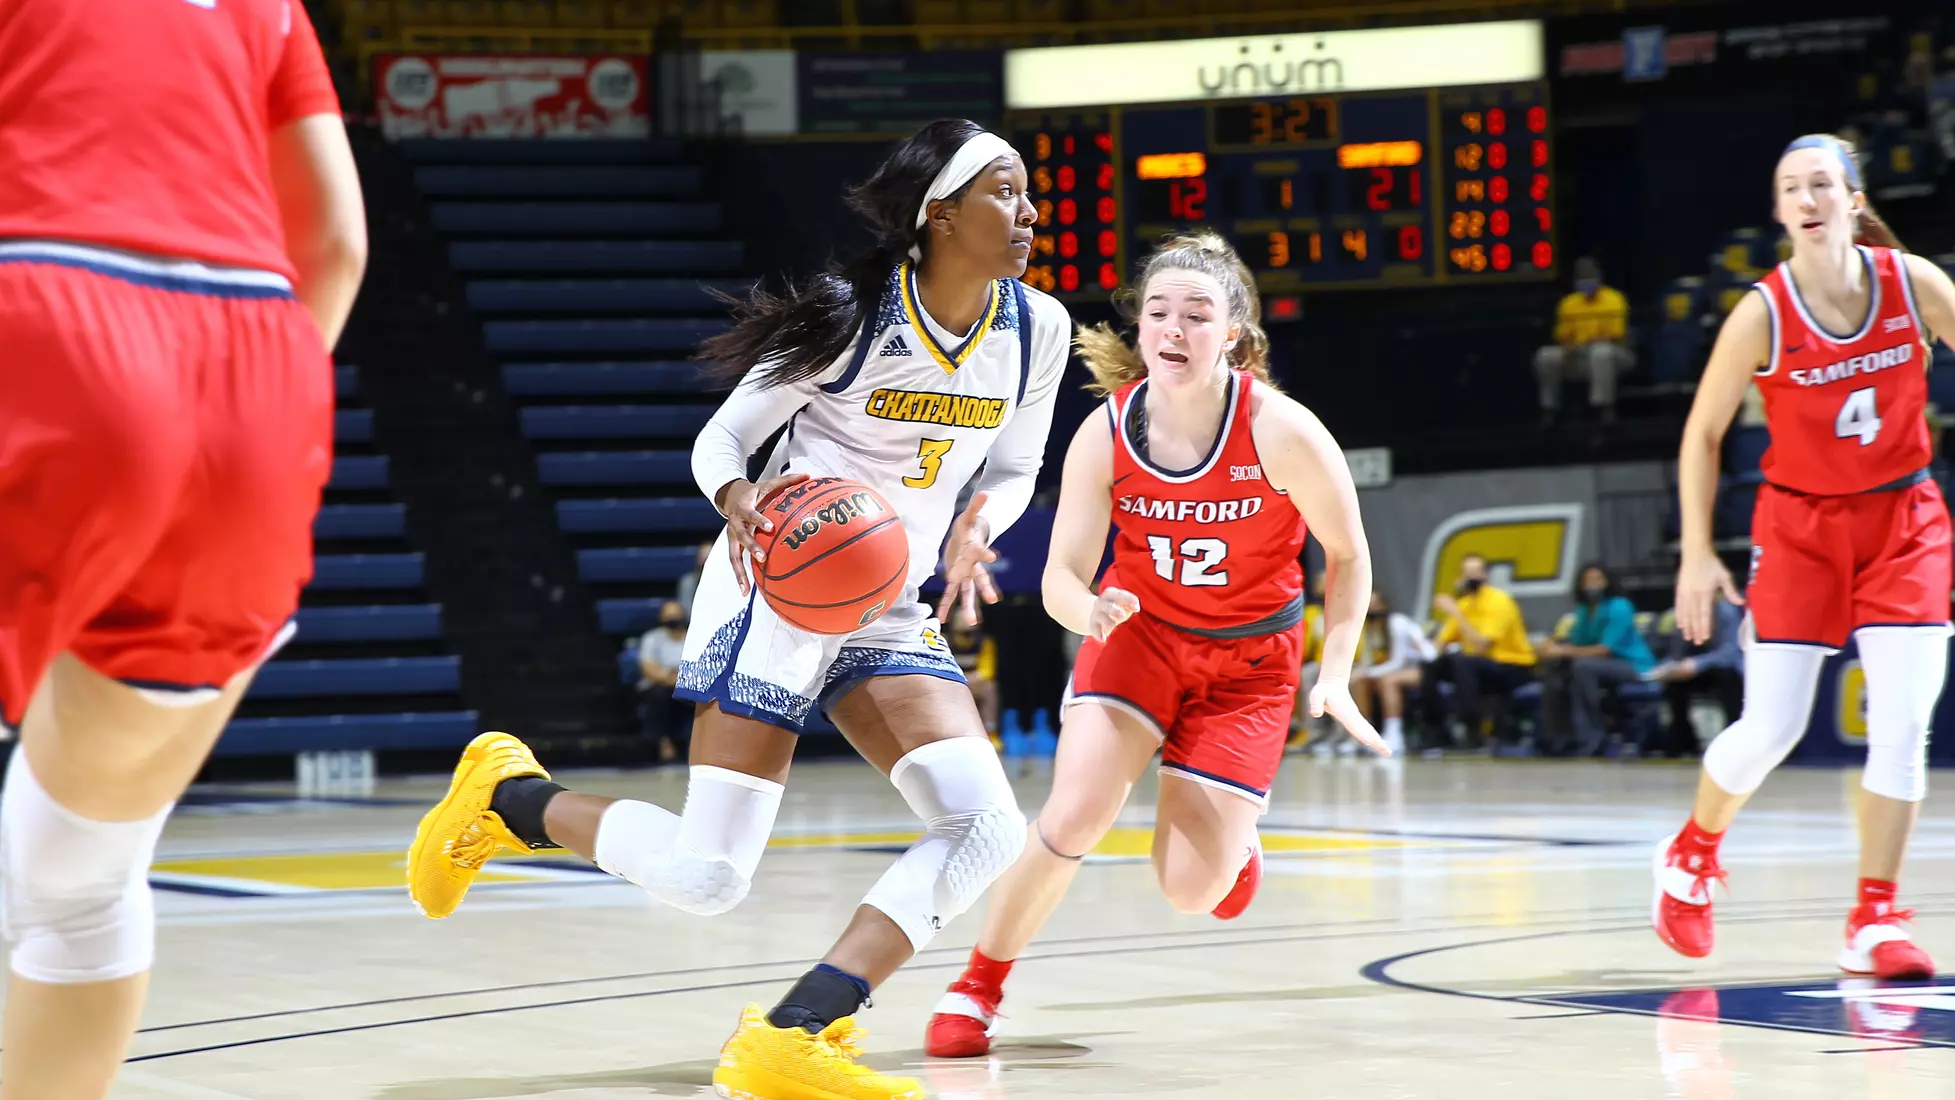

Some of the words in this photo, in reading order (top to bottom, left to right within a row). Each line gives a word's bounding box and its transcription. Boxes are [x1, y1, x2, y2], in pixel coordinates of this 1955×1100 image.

[1198, 42, 1343, 91] unum
[1252, 98, 1337, 144] 3:27
[1170, 177, 1207, 219] 12
[1281, 180, 1293, 209] 1
[1367, 167, 1421, 210] 21
[1269, 231, 1289, 267] 3
[1309, 233, 1322, 262] 1
[1342, 229, 1367, 261] 4
[1398, 225, 1422, 260] 0
[879, 349, 913, 357] adidas
[1788, 342, 1913, 387] SAMFORD
[865, 388, 1009, 429] CHATTANOOGA
[1835, 386, 1882, 446] 4
[901, 437, 955, 489] 3
[1230, 463, 1262, 482] SOCON
[783, 492, 886, 549] Wilson
[1118, 494, 1264, 524] SAMFORD
[1146, 534, 1229, 587] 12
